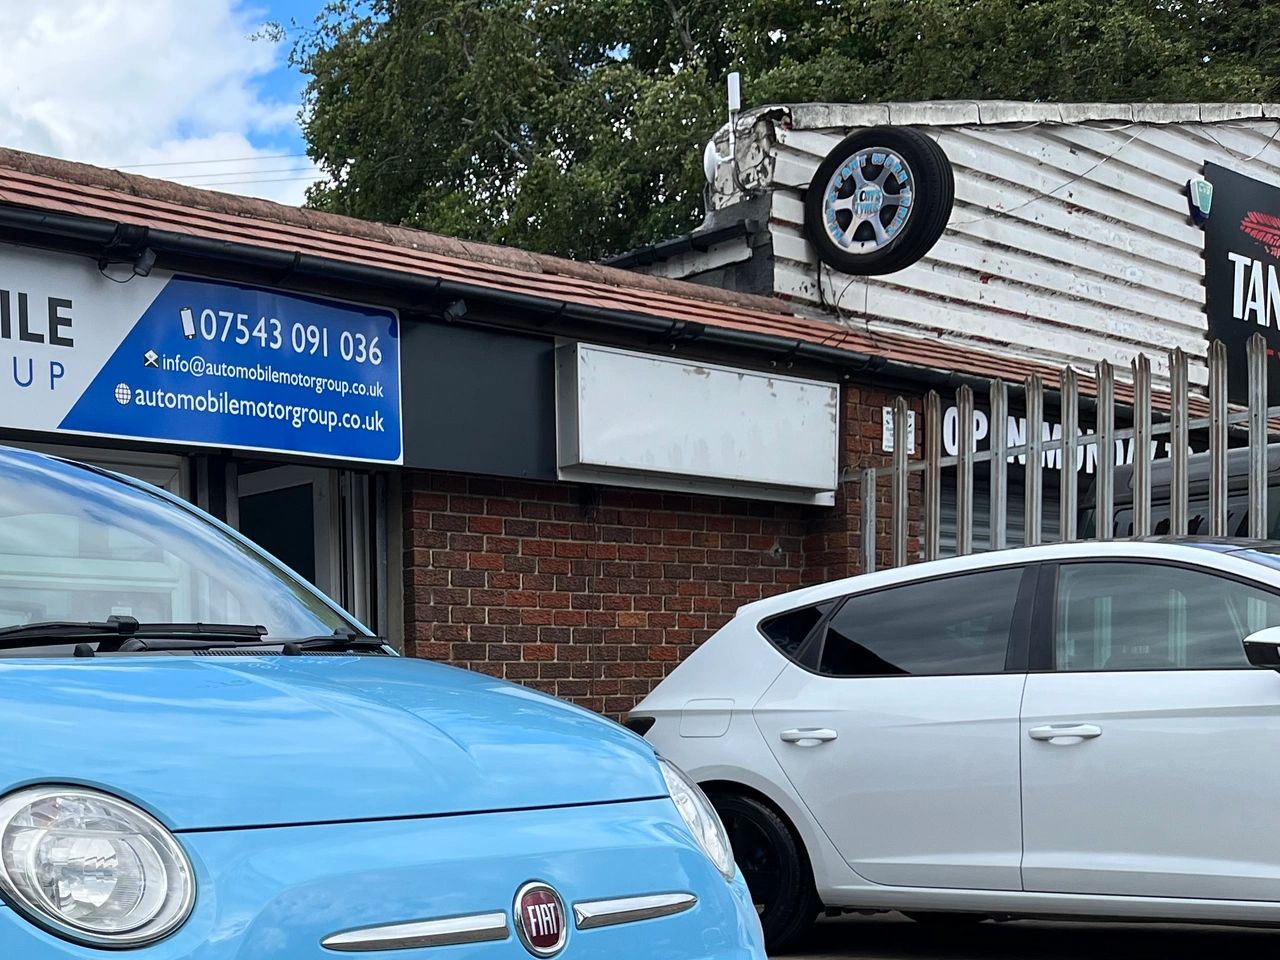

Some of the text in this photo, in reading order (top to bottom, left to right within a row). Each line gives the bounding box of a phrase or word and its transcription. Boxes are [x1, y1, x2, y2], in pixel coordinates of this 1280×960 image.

[199, 308, 383, 366] 07543 091 036
[162, 353, 384, 399] info@automobilemotorgroup.co.uk
[134, 386, 385, 433] automobilemotorgroup.co.uk
[942, 405, 1027, 466] OPN
[526, 901, 559, 938] FIAT
